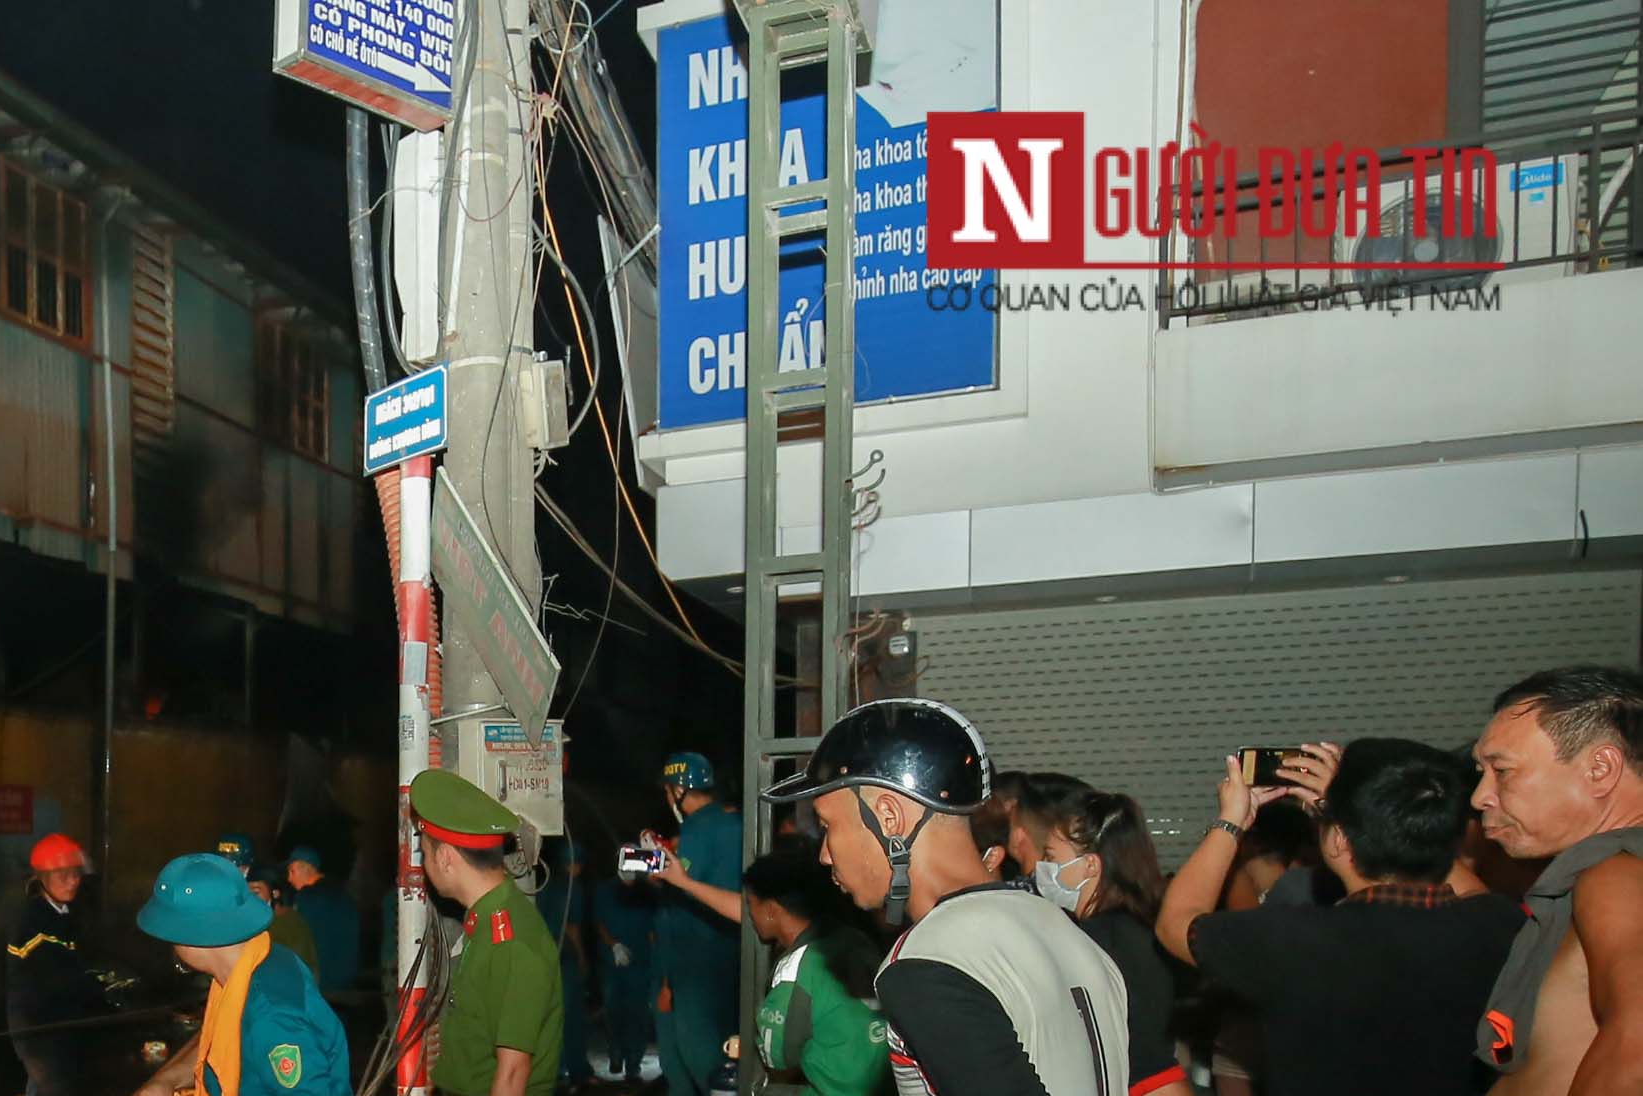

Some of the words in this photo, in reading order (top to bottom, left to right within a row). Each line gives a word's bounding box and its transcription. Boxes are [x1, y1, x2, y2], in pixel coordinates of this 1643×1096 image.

[310, 23, 324, 45] CÓ
[314, 3, 342, 27] CÓ
[420, 48, 452, 76] ĐÔI
[371, 8, 406, 36] MÁY
[420, 30, 453, 59] WIFI
[688, 46, 748, 111] NH
[688, 128, 809, 206] KHA
[854, 143, 871, 171] ha
[875, 136, 913, 167] khoa
[854, 187, 871, 214] ha
[875, 180, 913, 211] khoa
[853, 228, 874, 257] àm
[877, 224, 912, 256] răng
[688, 234, 747, 301] HU
[853, 264, 886, 300] hỉnh
[889, 265, 918, 296] nha
[688, 298, 827, 395] CHẨN
